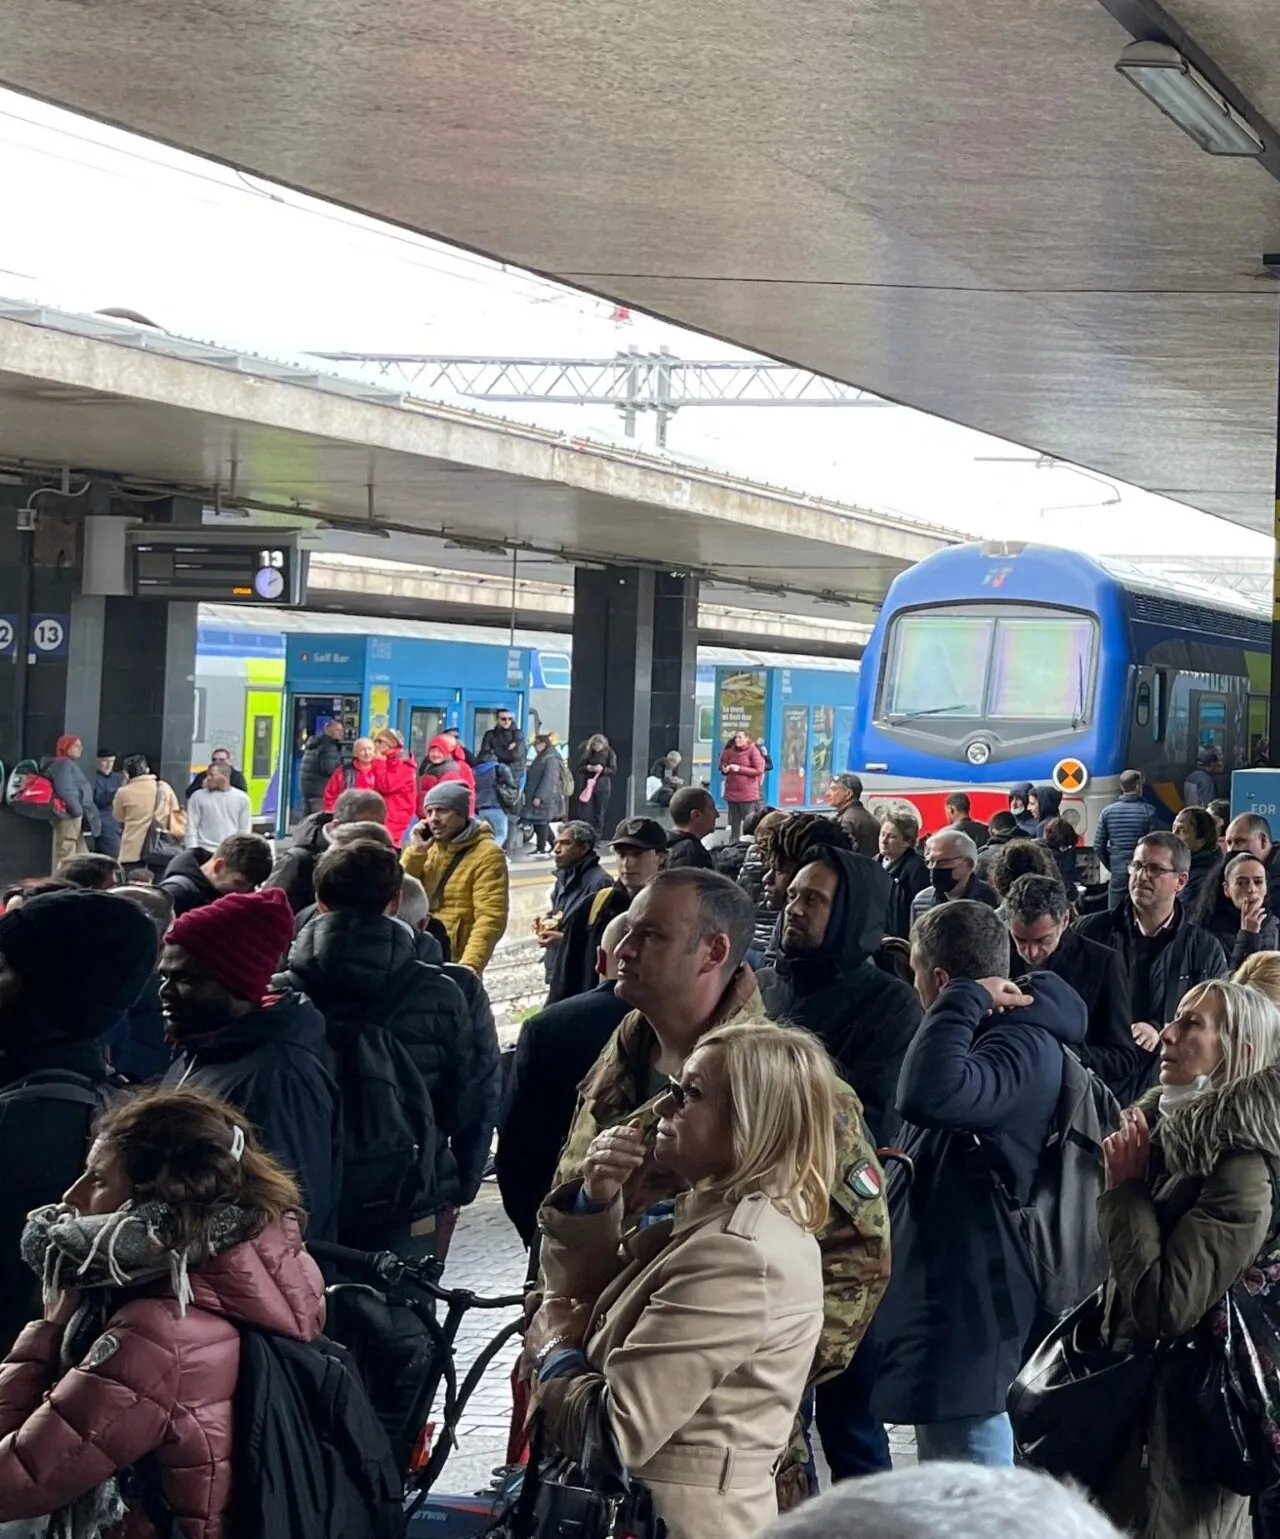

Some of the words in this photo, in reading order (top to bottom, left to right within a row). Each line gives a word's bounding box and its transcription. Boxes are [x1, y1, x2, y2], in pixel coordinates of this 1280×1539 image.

[261, 550, 283, 567] 13
[39, 626, 59, 643] 13
[313, 652, 331, 662] Self
[333, 653, 350, 663] Bar
[1251, 804, 1276, 815] FOR
